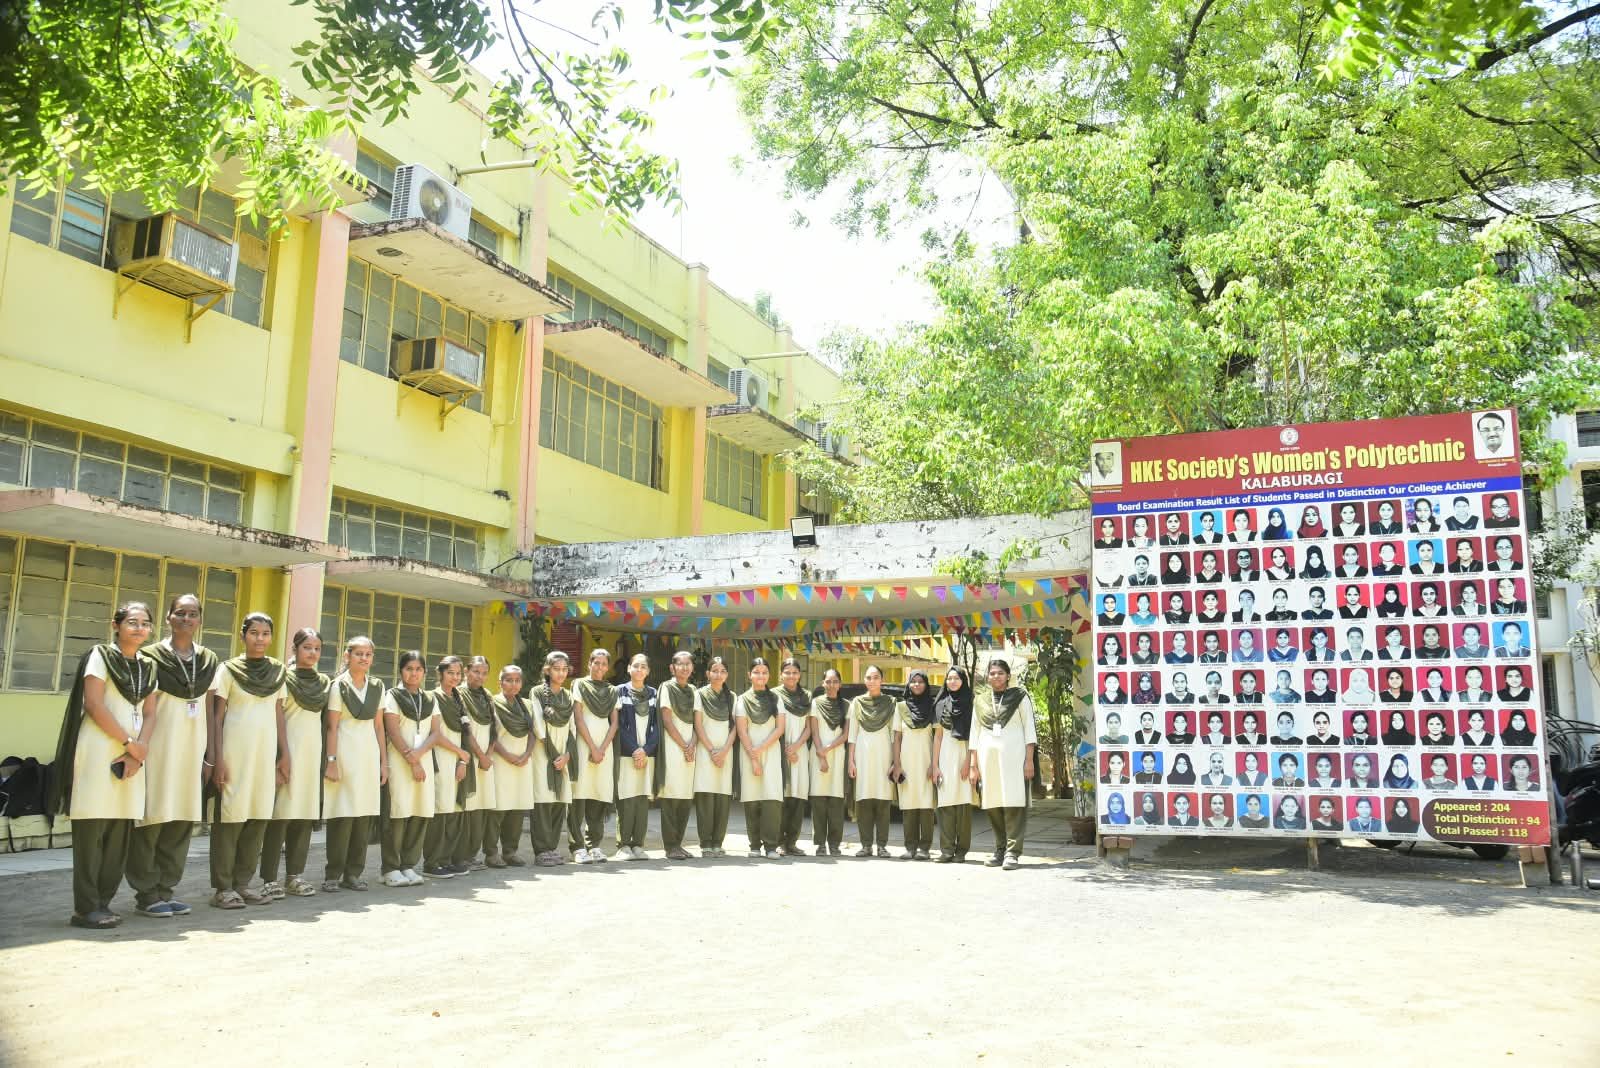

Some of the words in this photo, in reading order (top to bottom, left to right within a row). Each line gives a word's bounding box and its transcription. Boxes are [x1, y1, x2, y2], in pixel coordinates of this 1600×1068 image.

[1130, 459, 1163, 483] HKE
[1166, 454, 1249, 480] Society's
[1252, 447, 1341, 475] Women's
[1344, 437, 1466, 470] Polytechnic
[1241, 472, 1343, 490] KALABURAGI
[1117, 503, 1141, 512] Board
[1143, 499, 1194, 510] Examination
[1196, 498, 1222, 507] Result
[1224, 496, 1240, 505] List
[1242, 495, 1251, 504] of
[1253, 493, 1292, 503] Students
[1294, 490, 1324, 500] Passed
[1326, 490, 1336, 498] in
[1338, 486, 1387, 498] Distinction
[1388, 486, 1406, 494] Our
[1408, 482, 1442, 494] College
[1444, 480, 1486, 490] Achiever
[1433, 802, 1481, 812] Appeared
[1490, 803, 1510, 812] 204
[1434, 814, 1460, 823] Total
[1462, 815, 1518, 825] Distinction
[1526, 816, 1541, 826] 94
[1434, 826, 1460, 835] Total
[1463, 826, 1498, 836] Passed
[1508, 828, 1528, 838] 118
